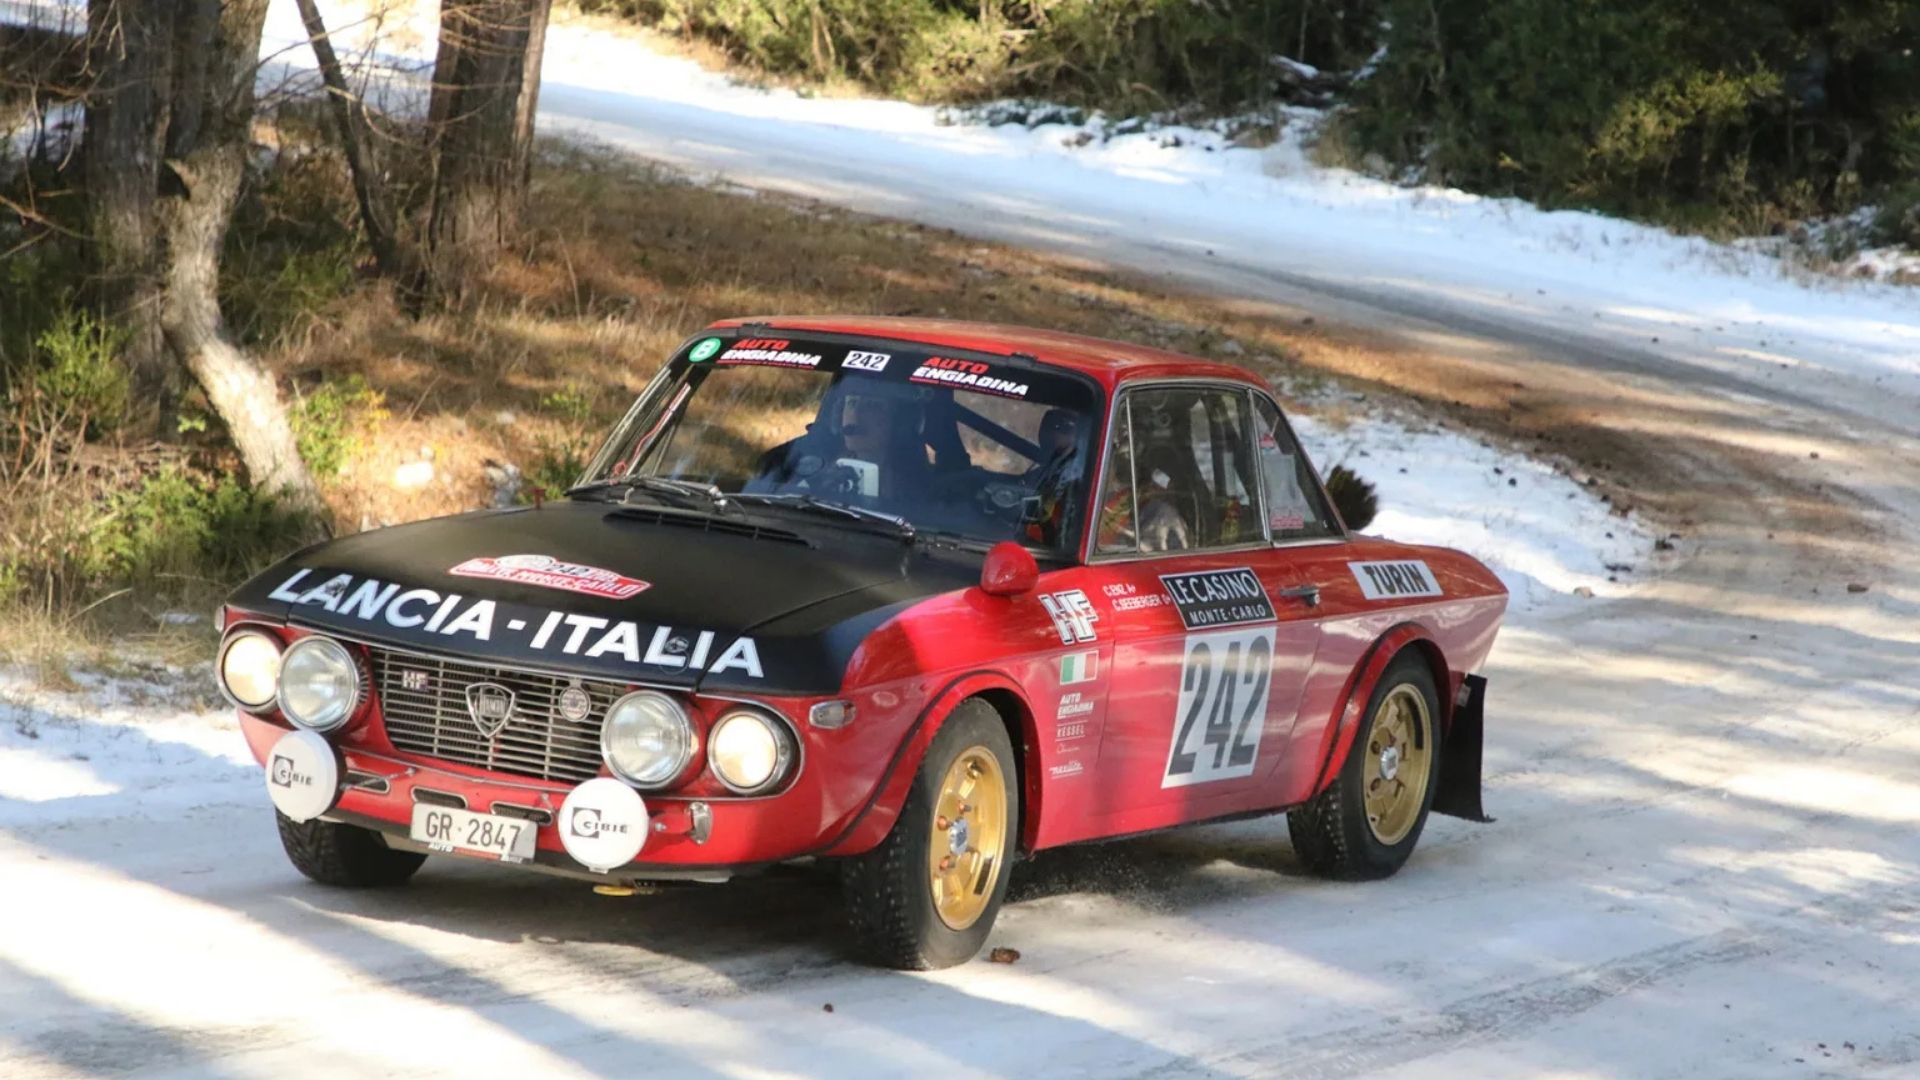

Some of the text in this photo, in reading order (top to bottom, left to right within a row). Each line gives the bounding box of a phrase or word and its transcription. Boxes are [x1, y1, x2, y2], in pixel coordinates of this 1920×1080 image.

[732, 339, 790, 350] AUTO
[720, 349, 822, 366] ENGIADINA
[848, 353, 886, 370] 242
[923, 356, 989, 374] AUTO
[912, 366, 1030, 396] ENGIADINA
[1167, 572, 1260, 604] LE CASINO
[1361, 564, 1431, 595] TURIN
[267, 568, 497, 641] LANCIA
[529, 610, 764, 678] ITALIA
[1038, 589, 1099, 645] HF
[403, 670, 428, 690] HF
[1060, 692, 1082, 705] AUTO
[1168, 636, 1270, 776] 242
